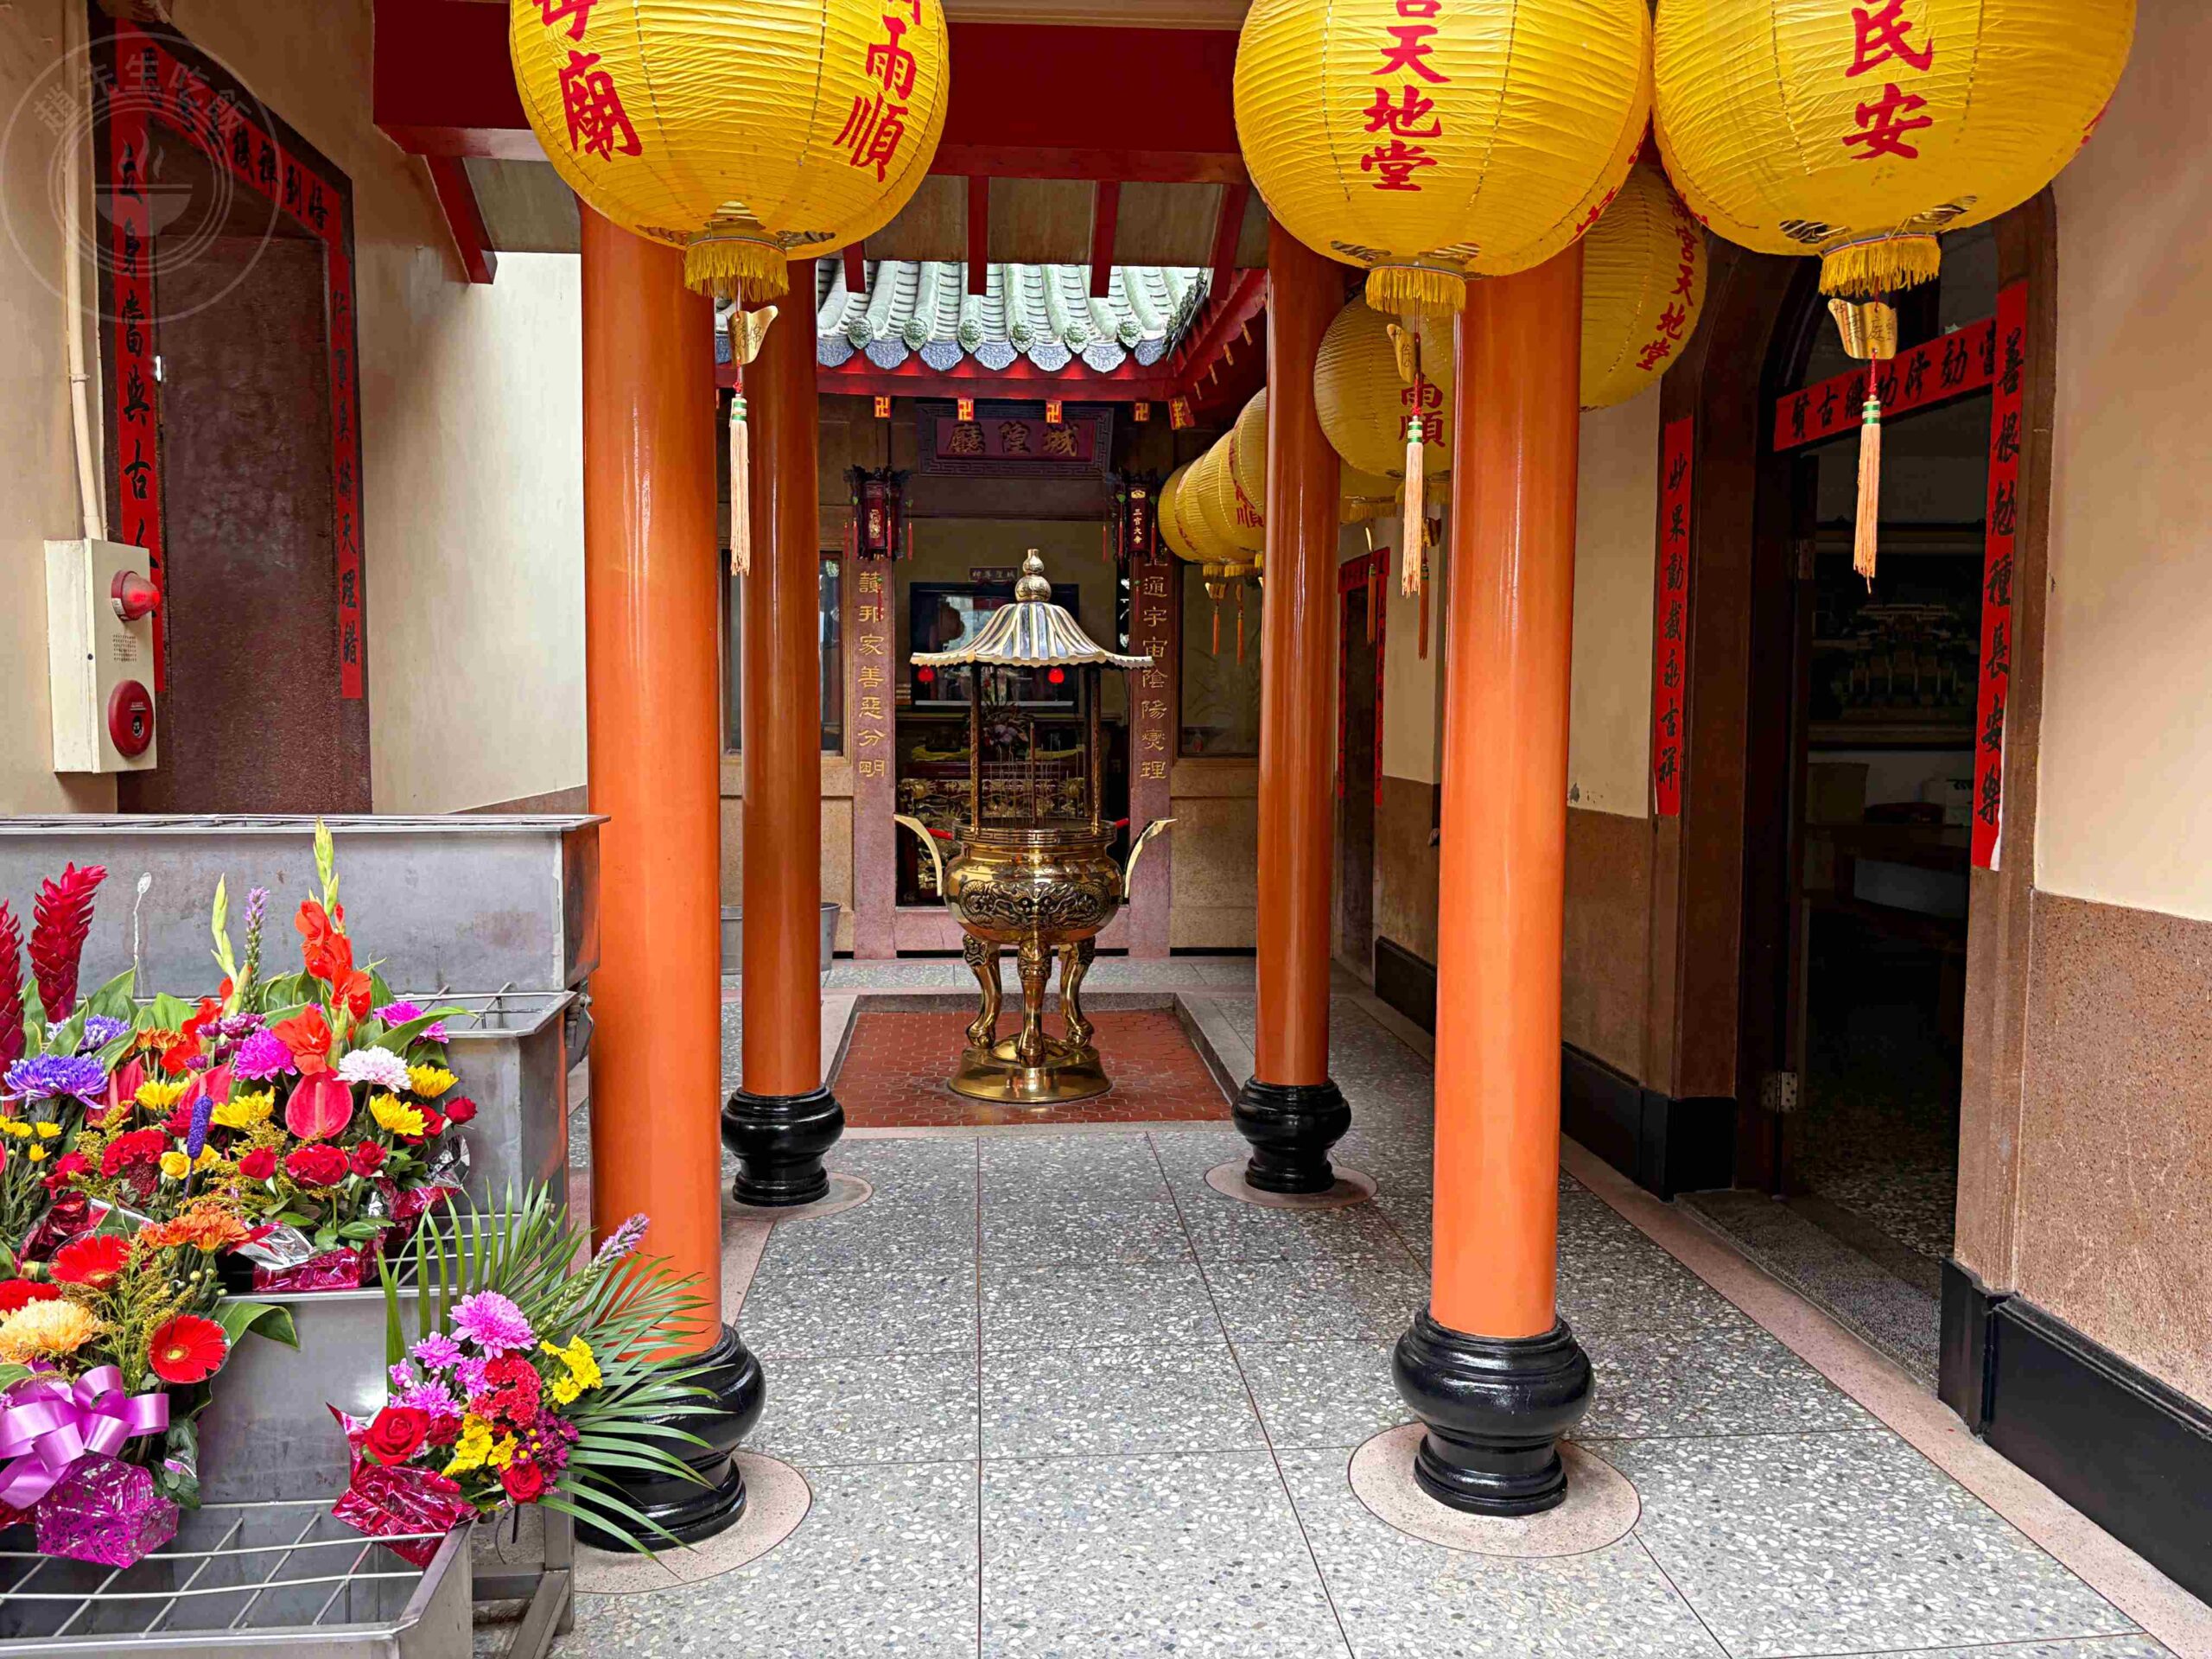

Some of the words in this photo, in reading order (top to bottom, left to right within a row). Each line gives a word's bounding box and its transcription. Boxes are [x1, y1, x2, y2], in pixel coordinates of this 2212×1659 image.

[1359, 0, 1451, 193] 天地堂
[1842, 6, 1934, 160] 民安
